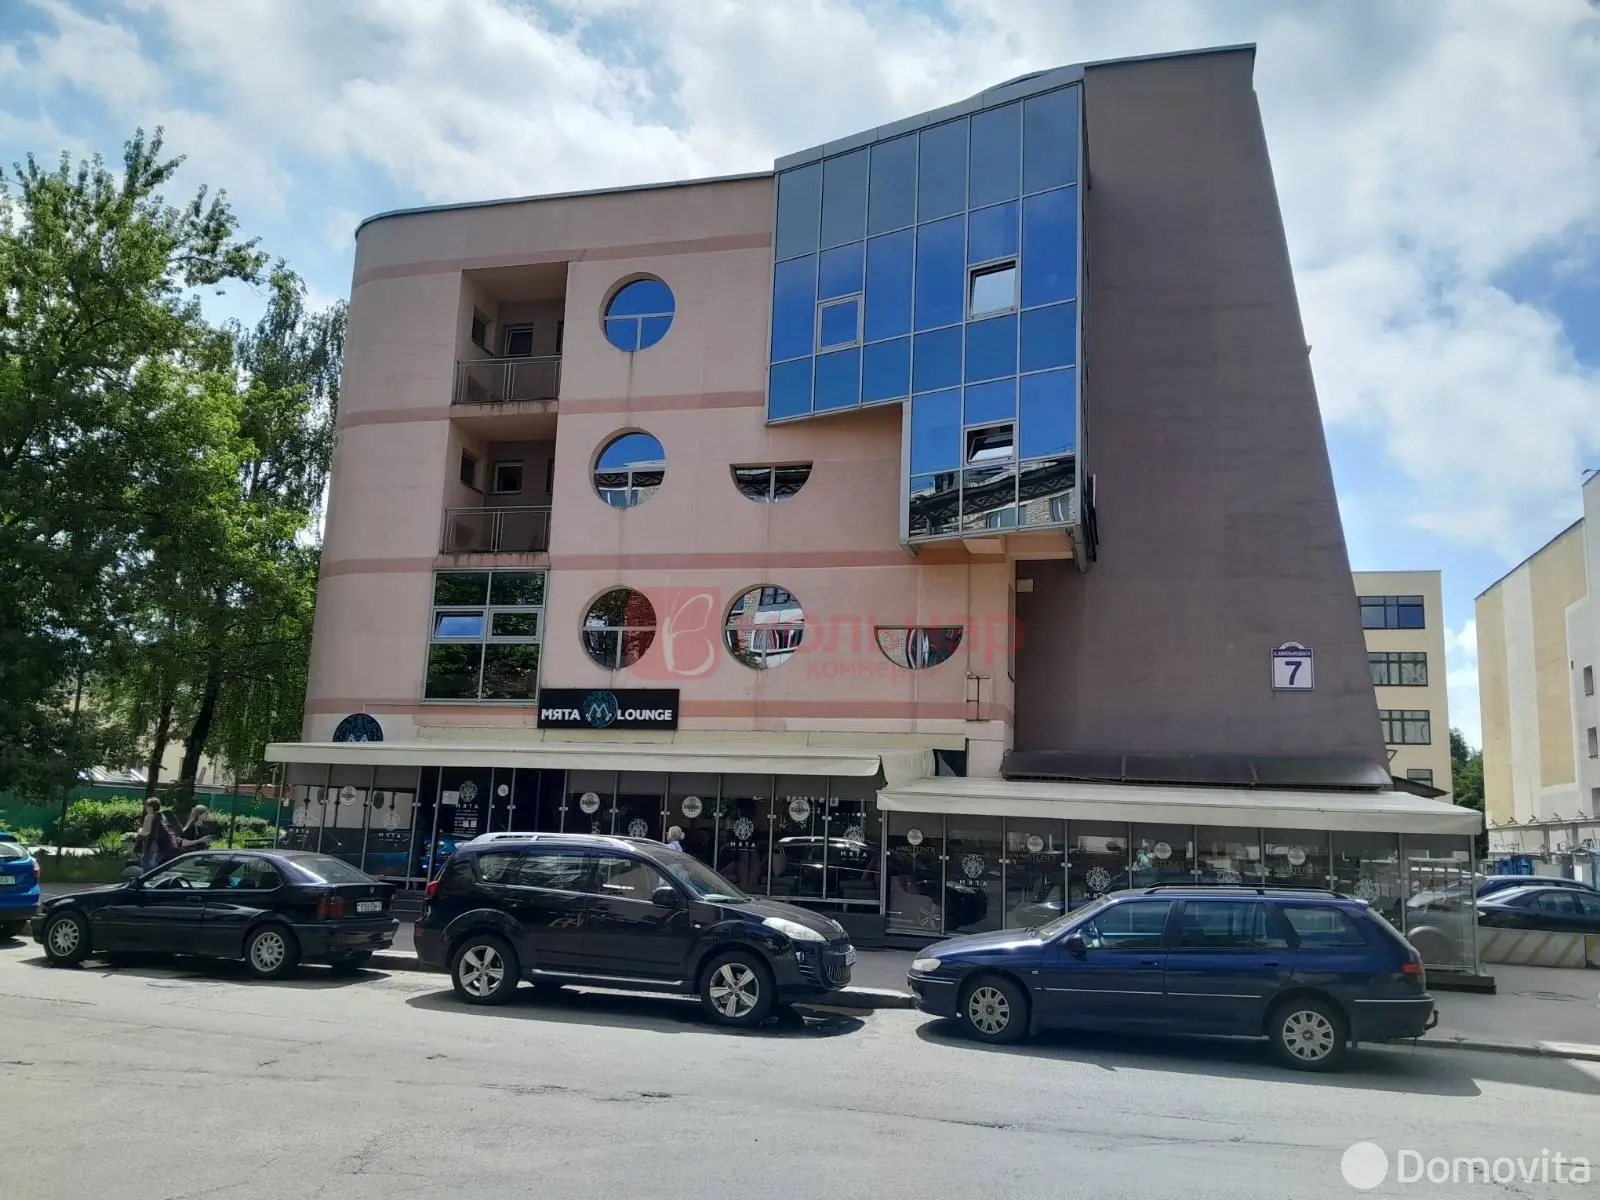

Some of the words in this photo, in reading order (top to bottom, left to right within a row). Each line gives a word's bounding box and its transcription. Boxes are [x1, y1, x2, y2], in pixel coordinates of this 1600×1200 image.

[1285, 661, 1302, 686] 7
[541, 708, 580, 721] МЯТА
[616, 709, 673, 721] LOUNGE
